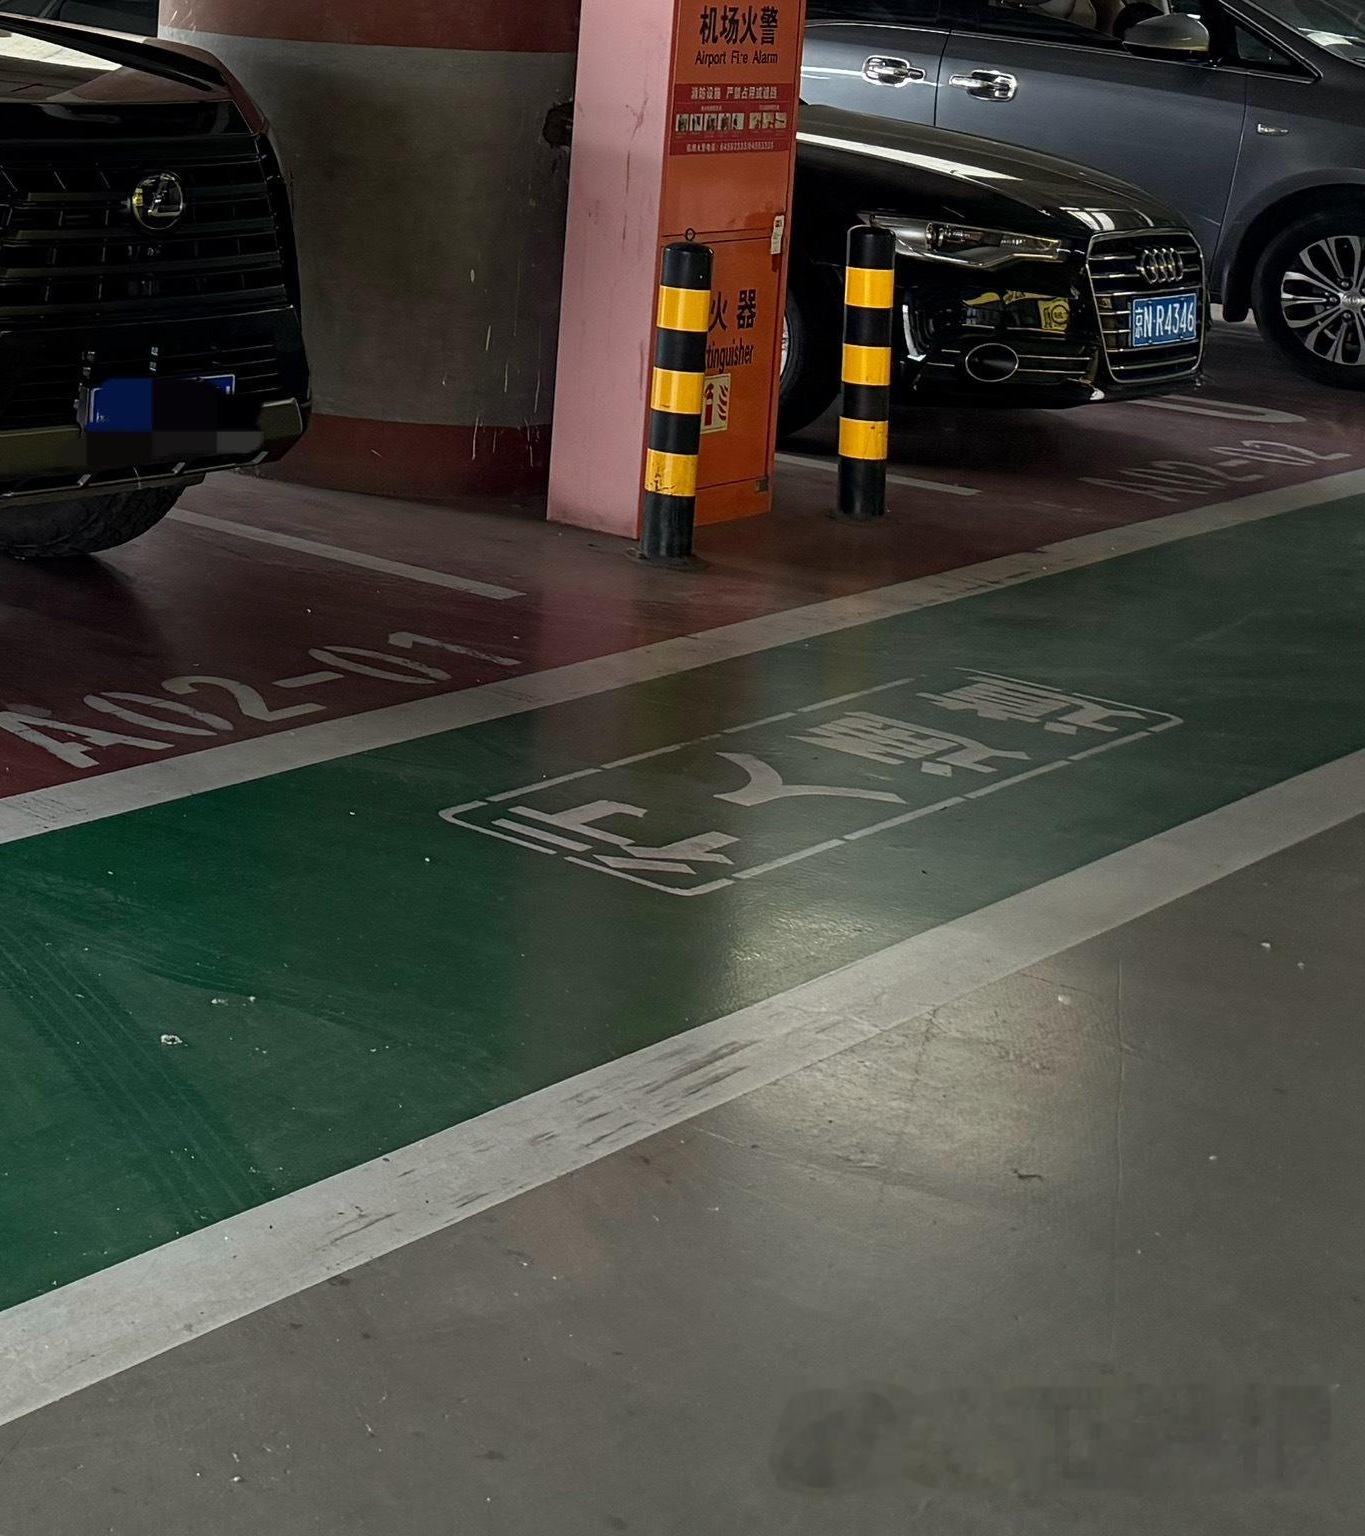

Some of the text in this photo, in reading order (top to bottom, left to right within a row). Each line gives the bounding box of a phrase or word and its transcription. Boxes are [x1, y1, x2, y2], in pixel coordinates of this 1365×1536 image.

[699, 5, 779, 46] 机场火警
[695, 50, 778, 67] Airport Fire Alarm
[708, 289, 757, 331] 火器
[706, 337, 754, 371] tinguisher
[492, 675, 1148, 875] 行人通道
